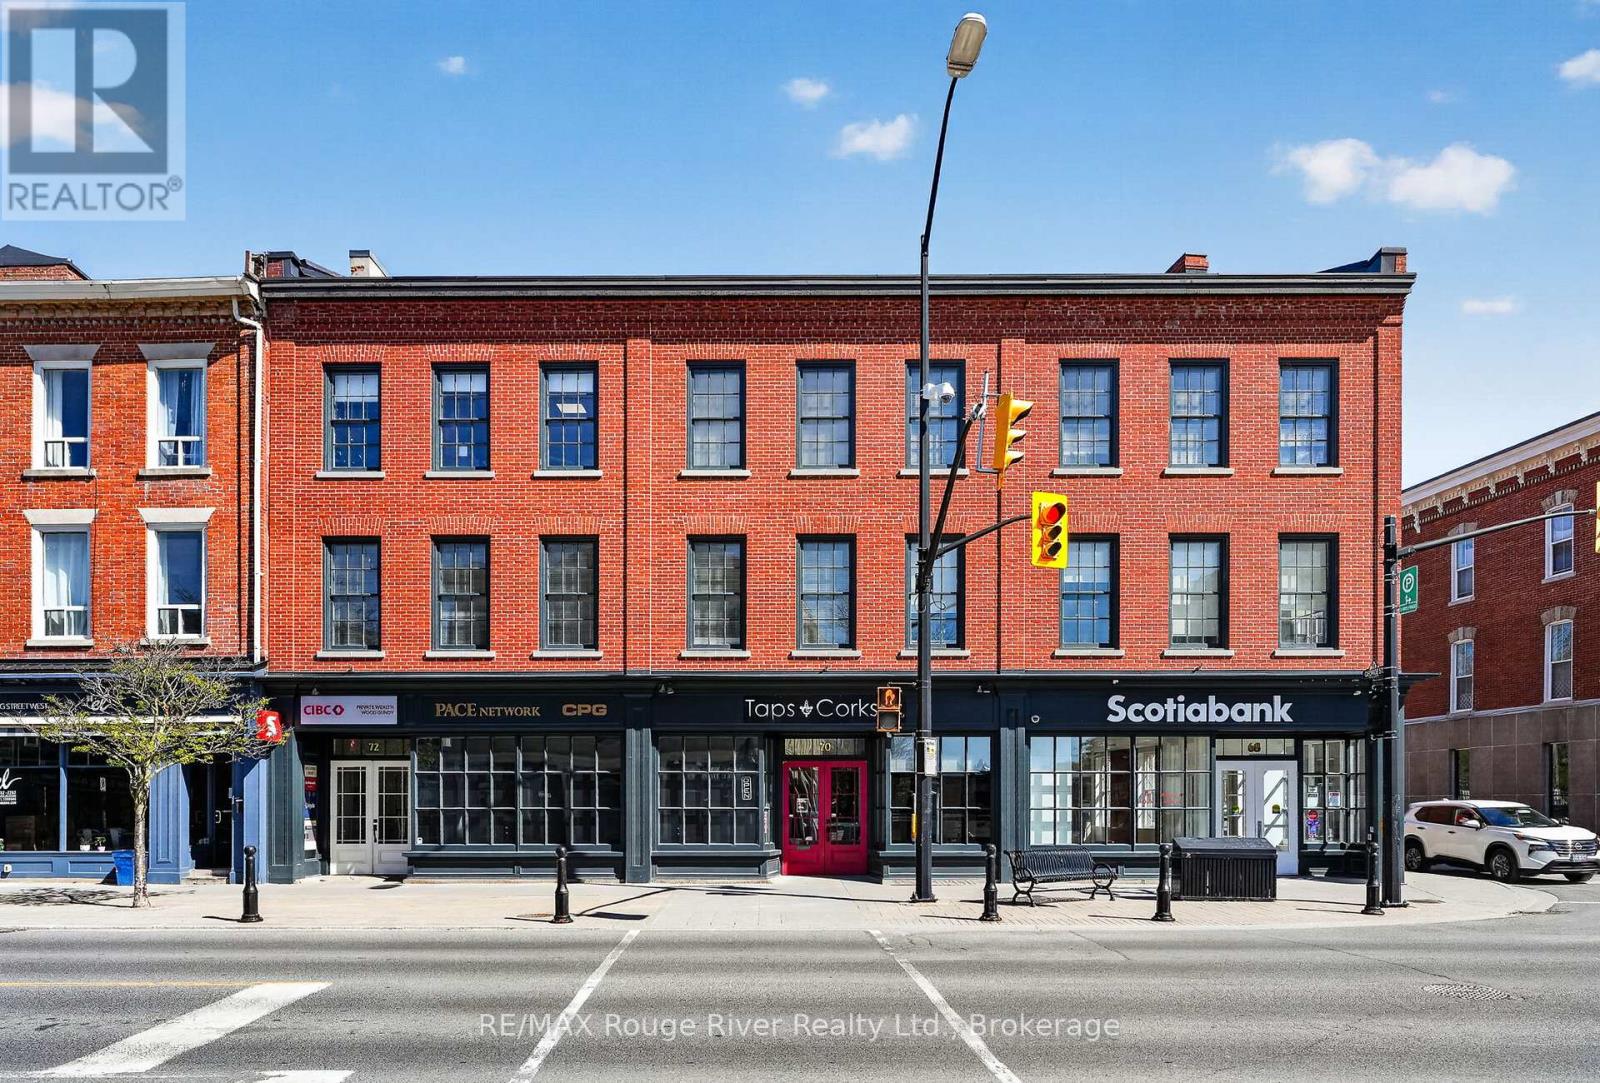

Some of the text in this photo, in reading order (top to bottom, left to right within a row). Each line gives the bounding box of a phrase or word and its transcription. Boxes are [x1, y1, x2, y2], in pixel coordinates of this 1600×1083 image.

[303, 705, 331, 716] CIBC
[435, 703, 541, 717] PACE NETWORK
[561, 703, 608, 716] CPG
[745, 698, 877, 720] Taps Corks
[1107, 695, 1294, 723] Scotiabank
[368, 742, 380, 752] 72
[819, 741, 832, 752] 70
